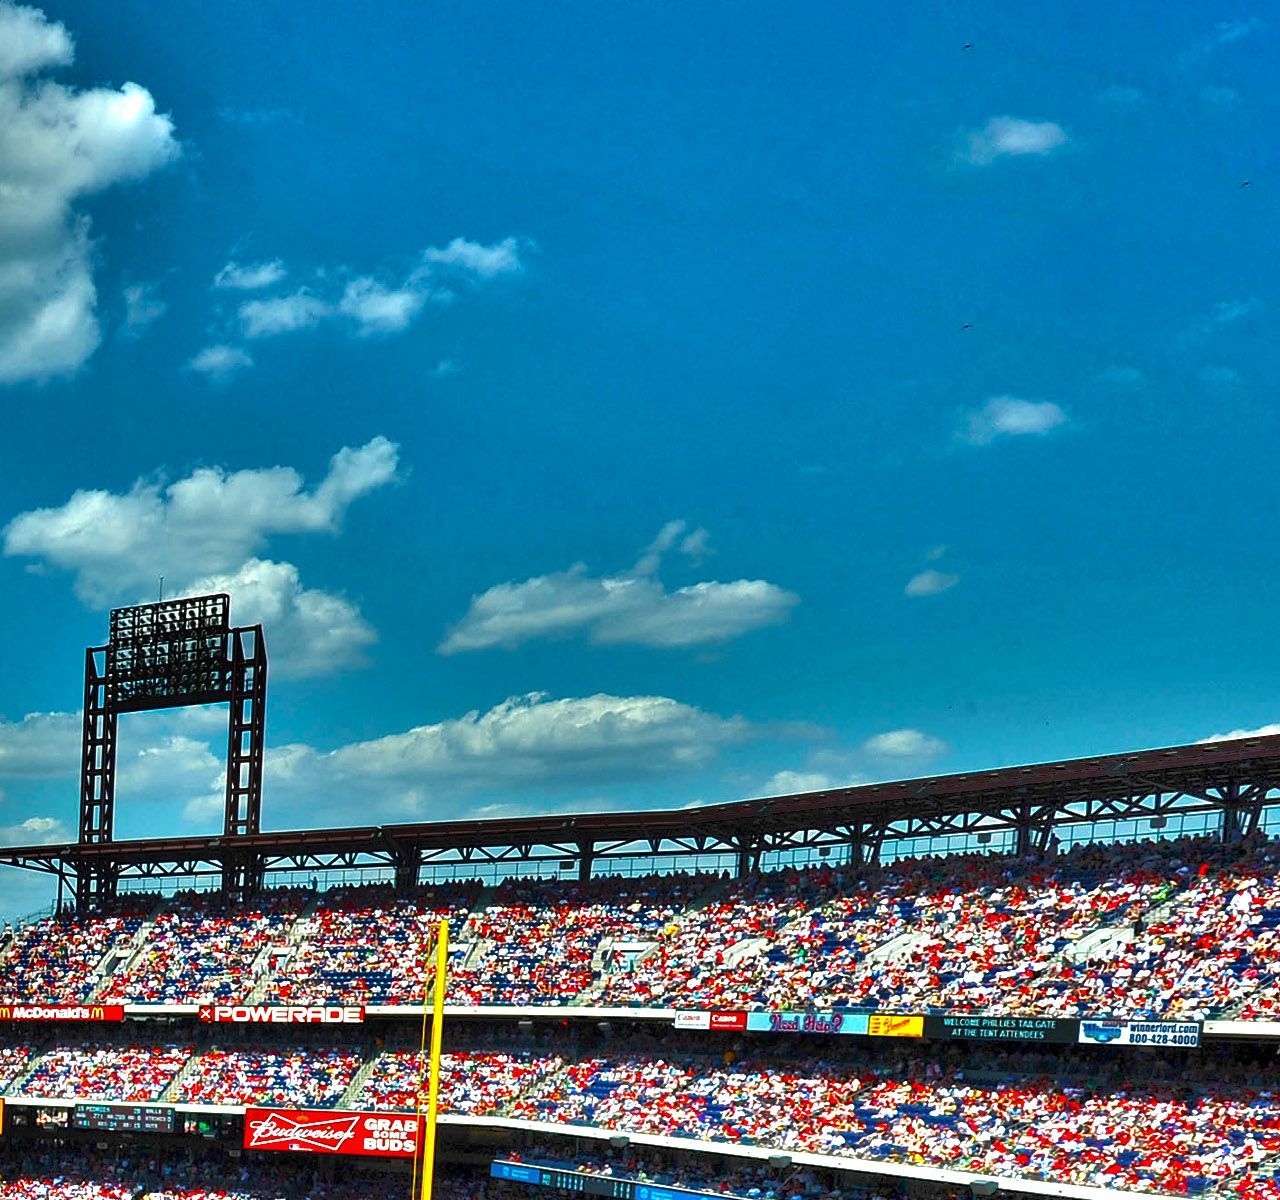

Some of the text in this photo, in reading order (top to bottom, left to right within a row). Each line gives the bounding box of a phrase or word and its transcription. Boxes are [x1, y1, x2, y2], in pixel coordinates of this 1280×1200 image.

[12, 1006, 89, 1020] McDonald's
[215, 1007, 363, 1022] POWERADE
[711, 1014, 737, 1023] Canon
[943, 1018, 1057, 1029] WELCOME PHILLIES TAILGATE
[1129, 1024, 1198, 1034] winnerford.com
[964, 1029, 977, 1037] THE
[979, 1030, 997, 1038] TENT
[999, 1030, 1045, 1040] ATTENDEES
[1129, 1034, 1197, 1045] 800-428-4000
[249, 1120, 356, 1140] Budweiser
[364, 1118, 417, 1133] GRAB
[372, 1130, 407, 1140] SOME
[363, 1138, 416, 1152] BUDS
